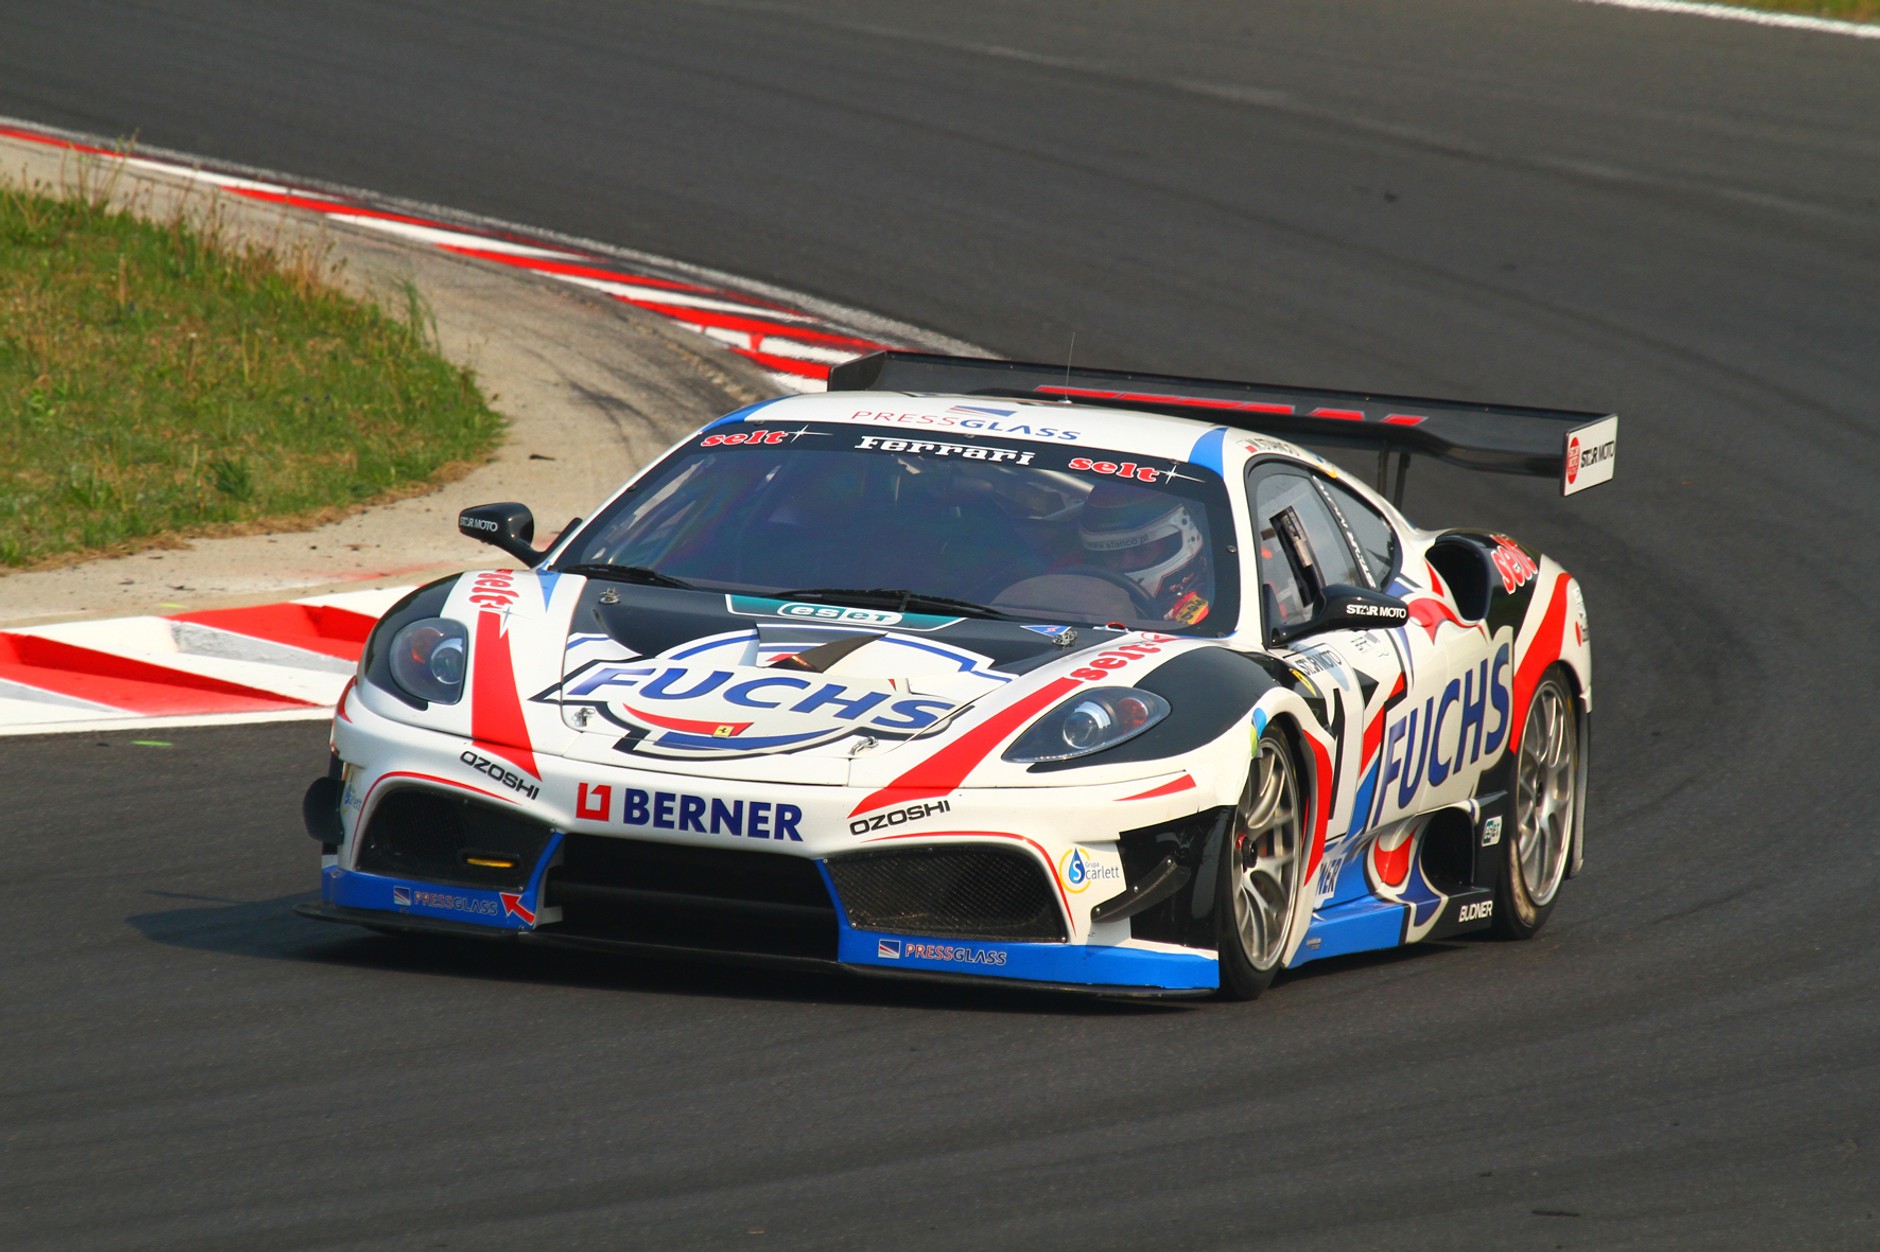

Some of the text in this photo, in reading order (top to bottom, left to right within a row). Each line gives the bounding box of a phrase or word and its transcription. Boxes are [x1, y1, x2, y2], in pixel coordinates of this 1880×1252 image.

[700, 429, 789, 447] selt
[854, 435, 1036, 466] Ferrari
[1068, 457, 1160, 483] selt
[475, 518, 498, 532] MOTO
[468, 572, 520, 606] selt
[1346, 604, 1406, 619] STAR MOTO
[1070, 643, 1161, 681] selt
[566, 667, 955, 729] FUCHS
[1371, 642, 1510, 829] FUCHS
[460, 750, 540, 801] OZOSHI
[623, 787, 804, 842] BERNER
[849, 799, 951, 836] OZOSHI
[1458, 900, 1494, 922] BUDNER
